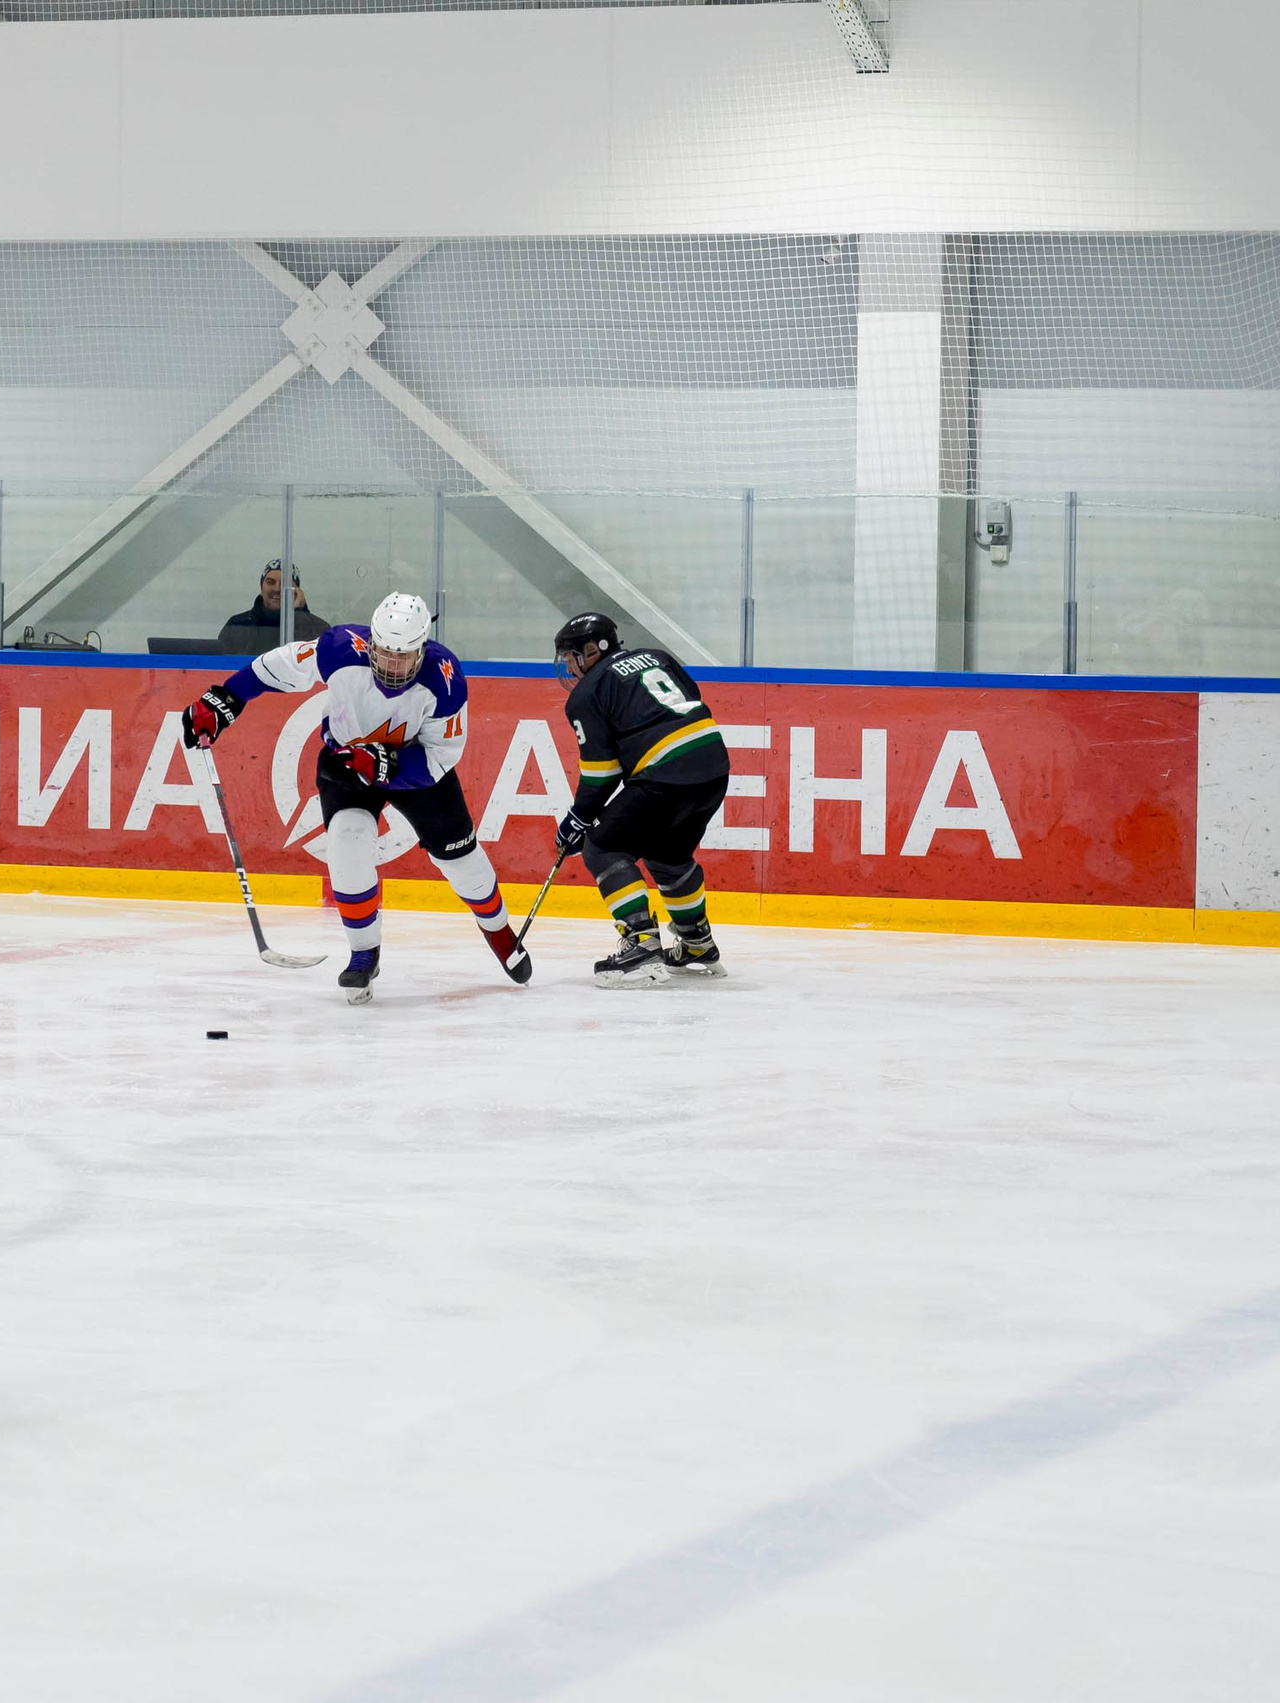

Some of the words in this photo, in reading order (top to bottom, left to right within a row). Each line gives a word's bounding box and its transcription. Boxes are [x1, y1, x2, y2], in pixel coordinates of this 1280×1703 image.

[612, 653, 660, 677] GEINTS
[641, 667, 703, 715] 9
[443, 711, 463, 738] 11
[477, 719, 1023, 860] АЕНА
[236, 868, 256, 908] CCM
